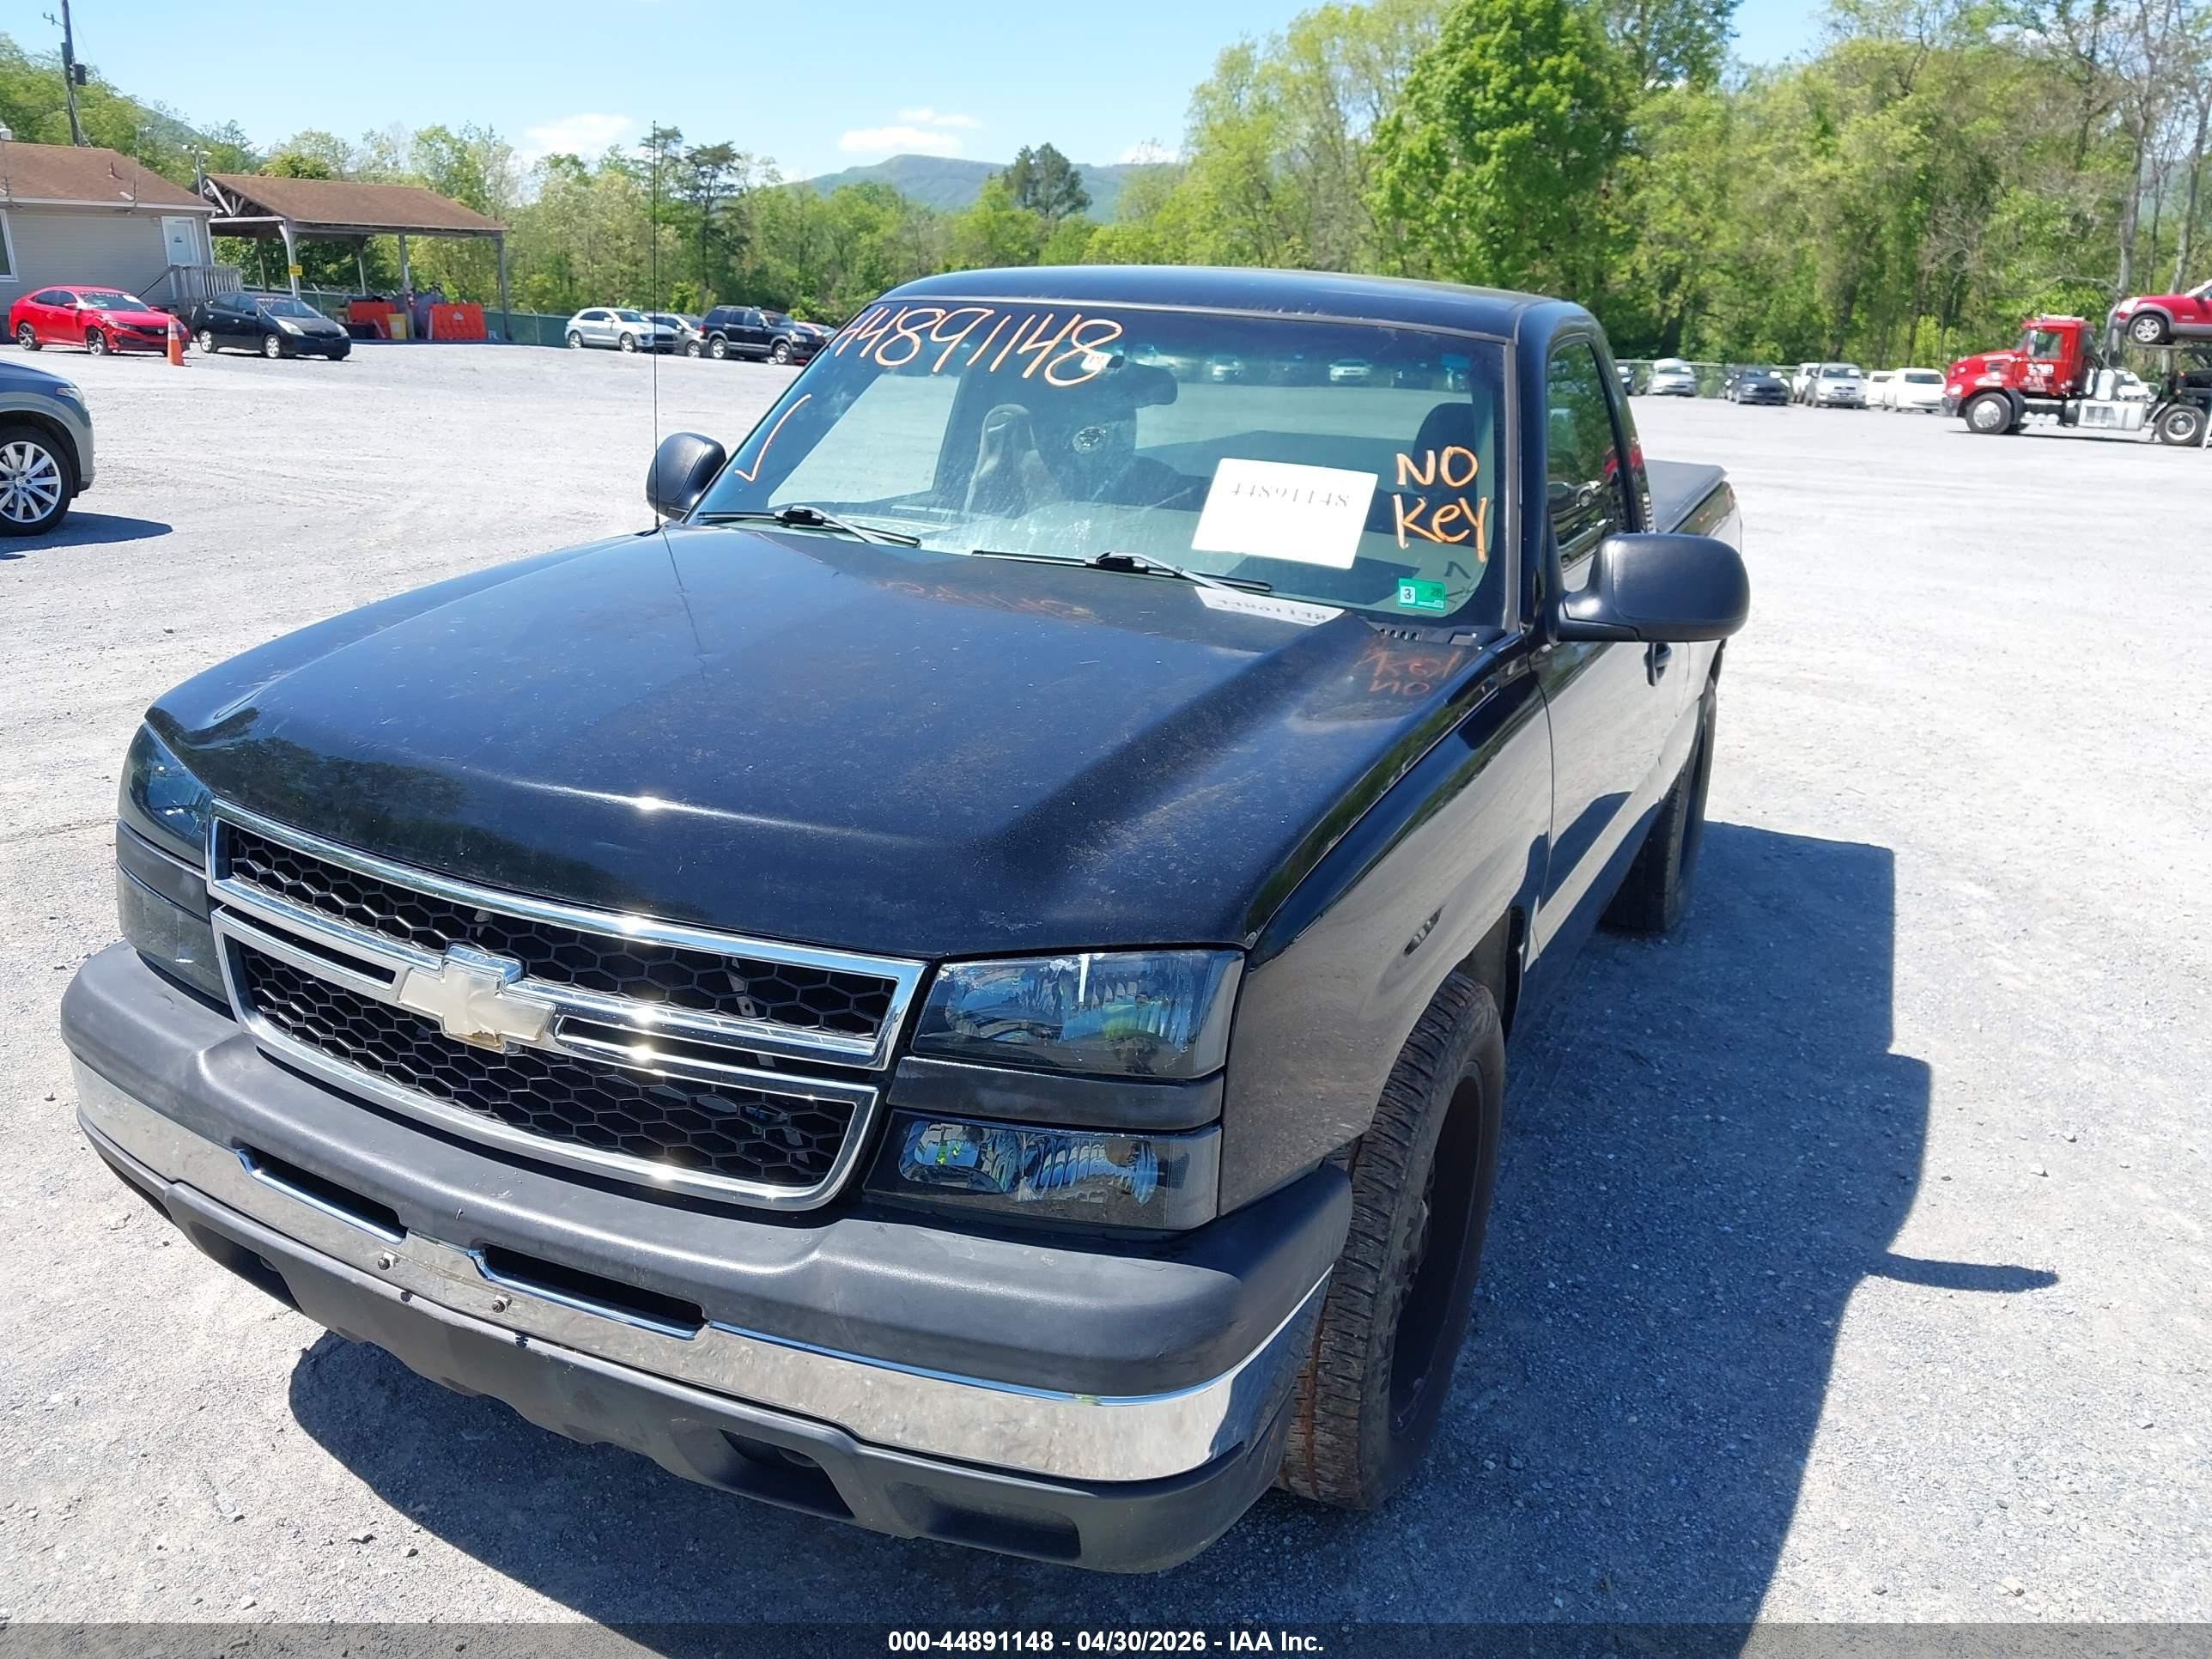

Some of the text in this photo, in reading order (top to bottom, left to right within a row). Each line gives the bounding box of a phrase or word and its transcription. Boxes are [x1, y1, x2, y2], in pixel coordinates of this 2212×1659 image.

[826, 306, 1122, 386] 44891148
[1396, 446, 1479, 487] NO
[1403, 587, 1413, 600] 3
